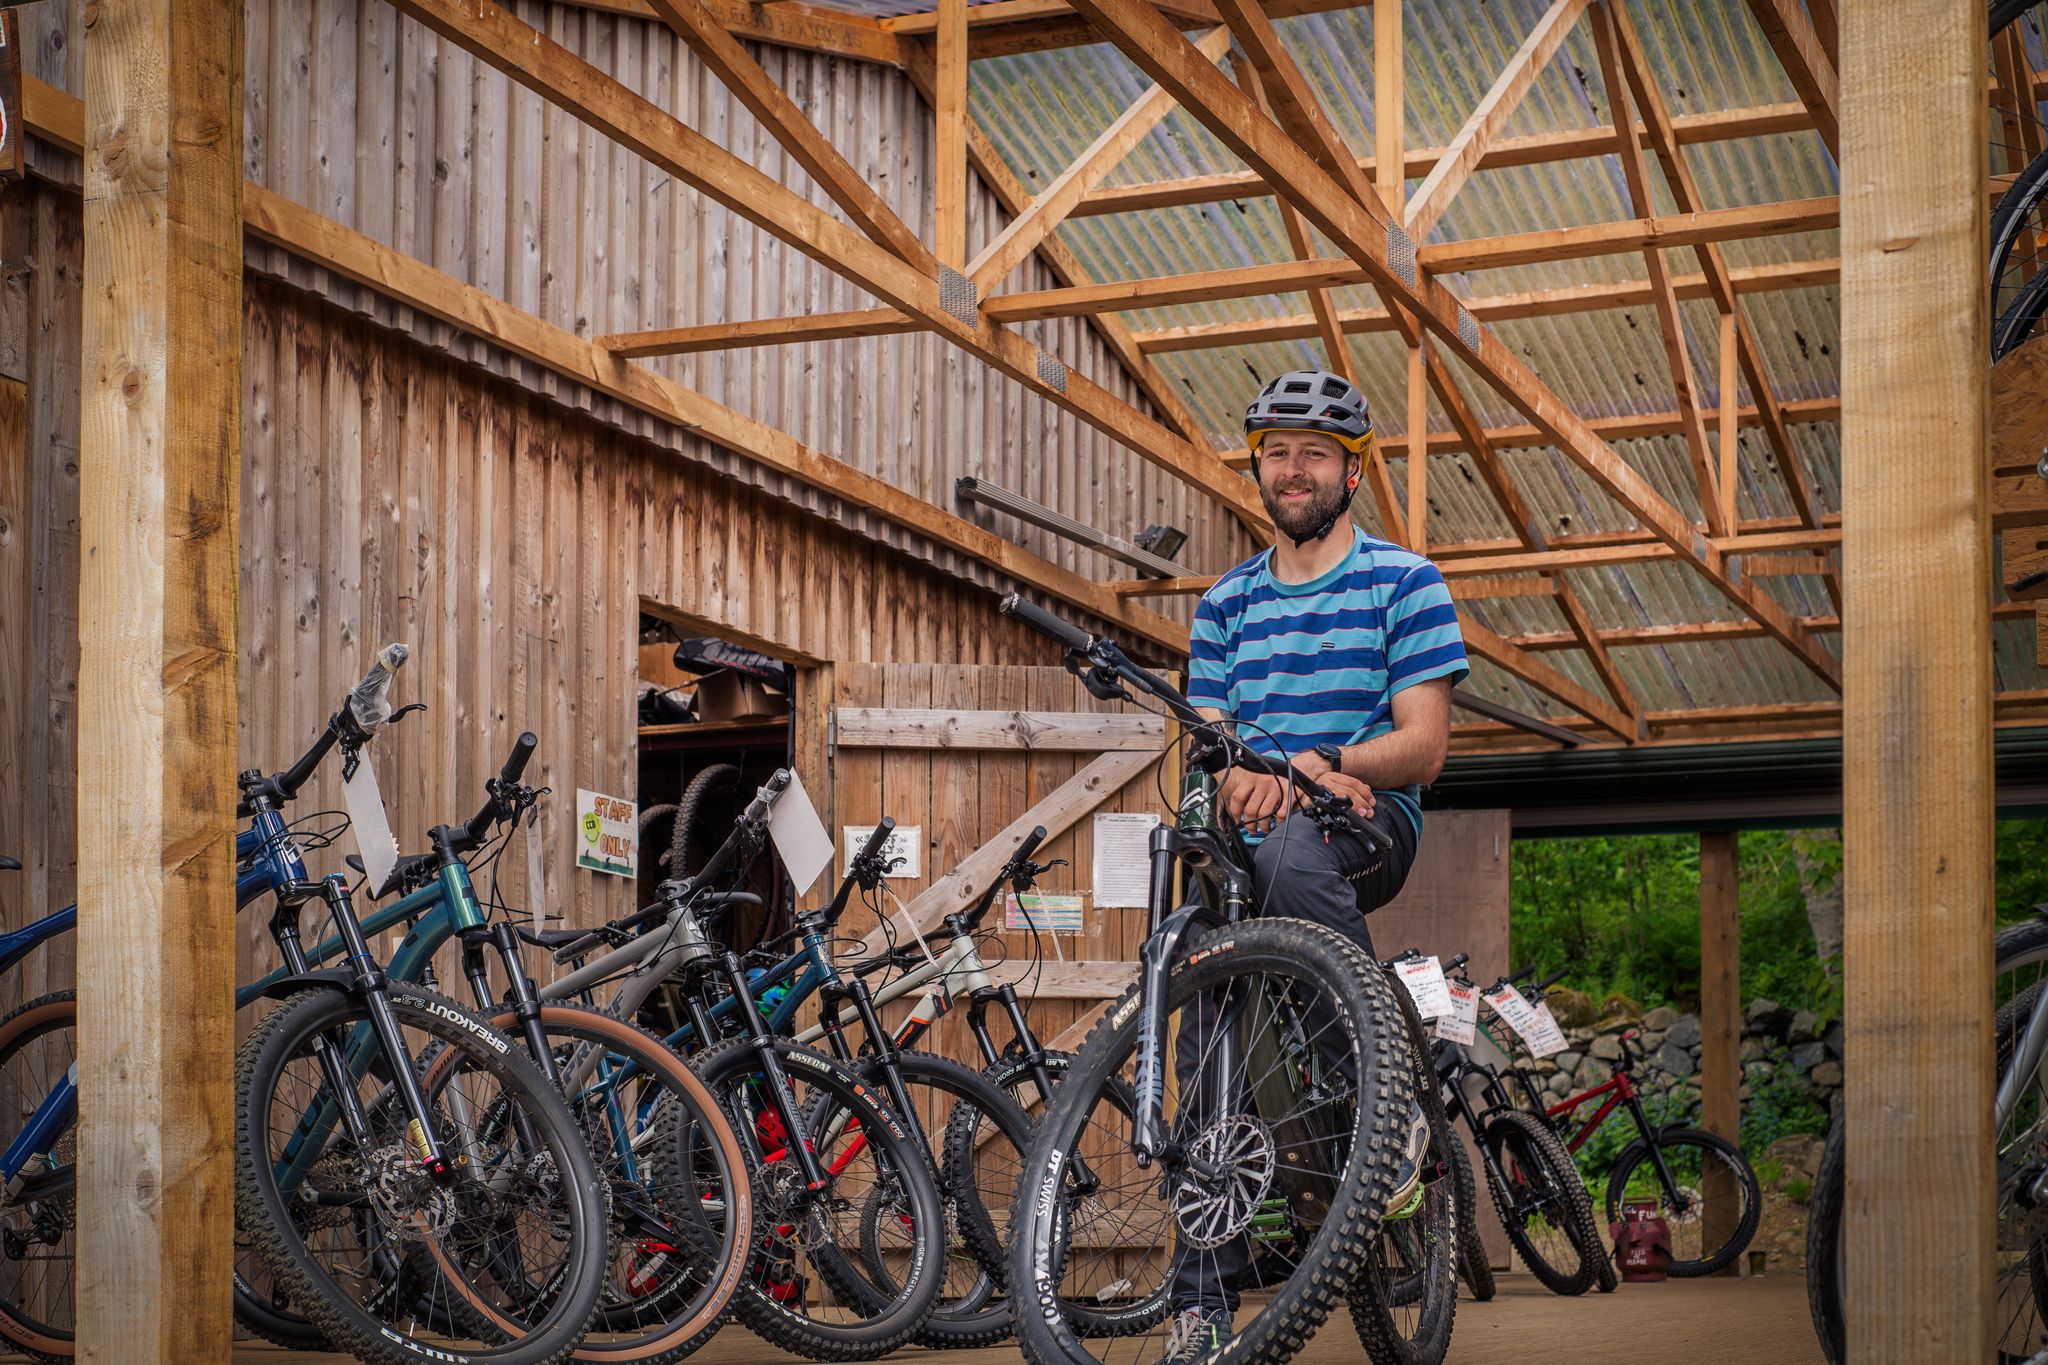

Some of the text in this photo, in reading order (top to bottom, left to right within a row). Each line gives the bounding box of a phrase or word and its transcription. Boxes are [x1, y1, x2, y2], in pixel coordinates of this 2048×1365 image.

[594, 796, 632, 824] STAFF
[585, 820, 596, 830] CCB
[600, 833, 631, 859] ONLY
[426, 1001, 509, 1054] BREAKOUT
[787, 1050, 831, 1073] ASSEGAI
[994, 1068, 1014, 1085] FRONT
[1419, 1074, 1430, 1091] DT
[1037, 1149, 1063, 1217] DT SWISS
[1448, 1194, 1457, 1283] MAXXIS
[670, 1267, 693, 1291] WILD
[1035, 1276, 1058, 1319] 1900
[1105, 1300, 1164, 1320] WILD ENDURO
[380, 1327, 455, 1363] WTB
